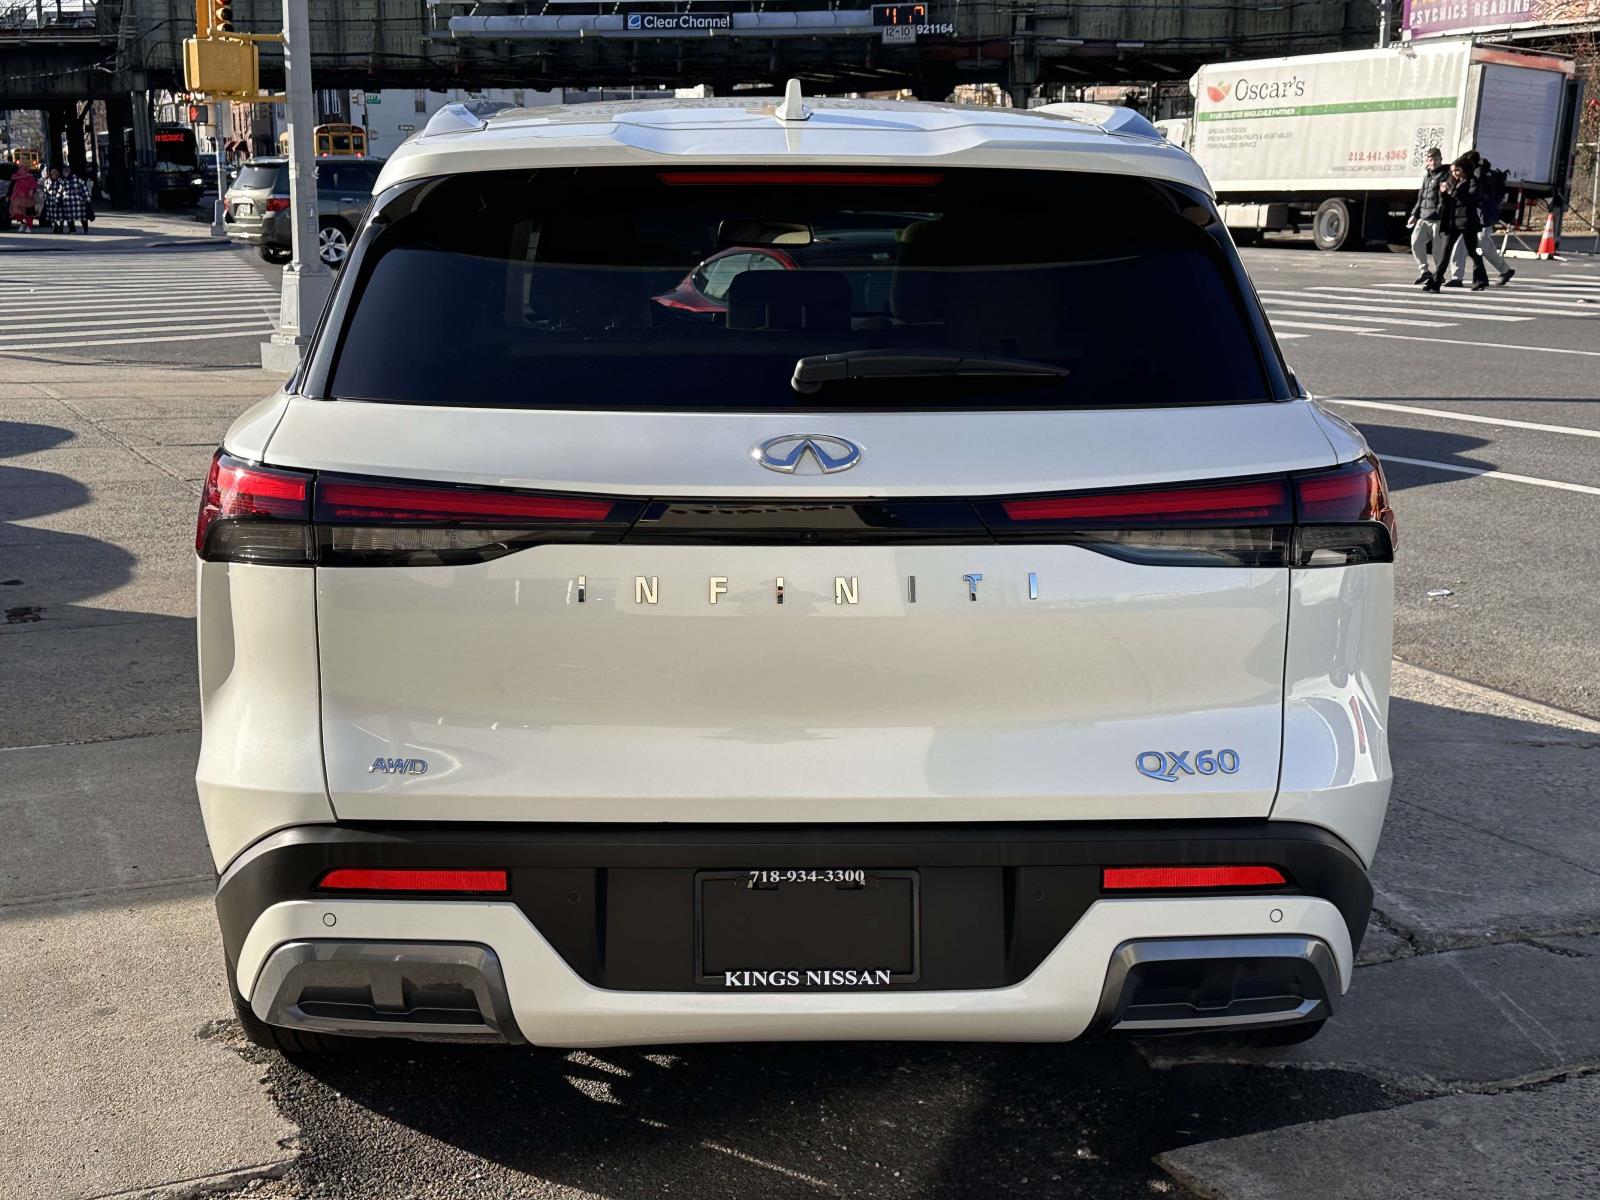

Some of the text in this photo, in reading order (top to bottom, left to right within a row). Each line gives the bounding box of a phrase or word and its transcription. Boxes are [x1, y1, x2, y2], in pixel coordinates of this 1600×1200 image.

[644, 15, 730, 28] Clear Channel
[1409, 0, 1530, 26] PSYCHICS READING
[917, 23, 954, 34] 921164
[1235, 76, 1305, 101] Oscar's
[578, 573, 1038, 604] INFINITI
[368, 757, 428, 775] AWD
[1135, 748, 1240, 782] QX60
[750, 870, 865, 882] 718-934-3300
[725, 970, 891, 986] KINGS NISSAN
